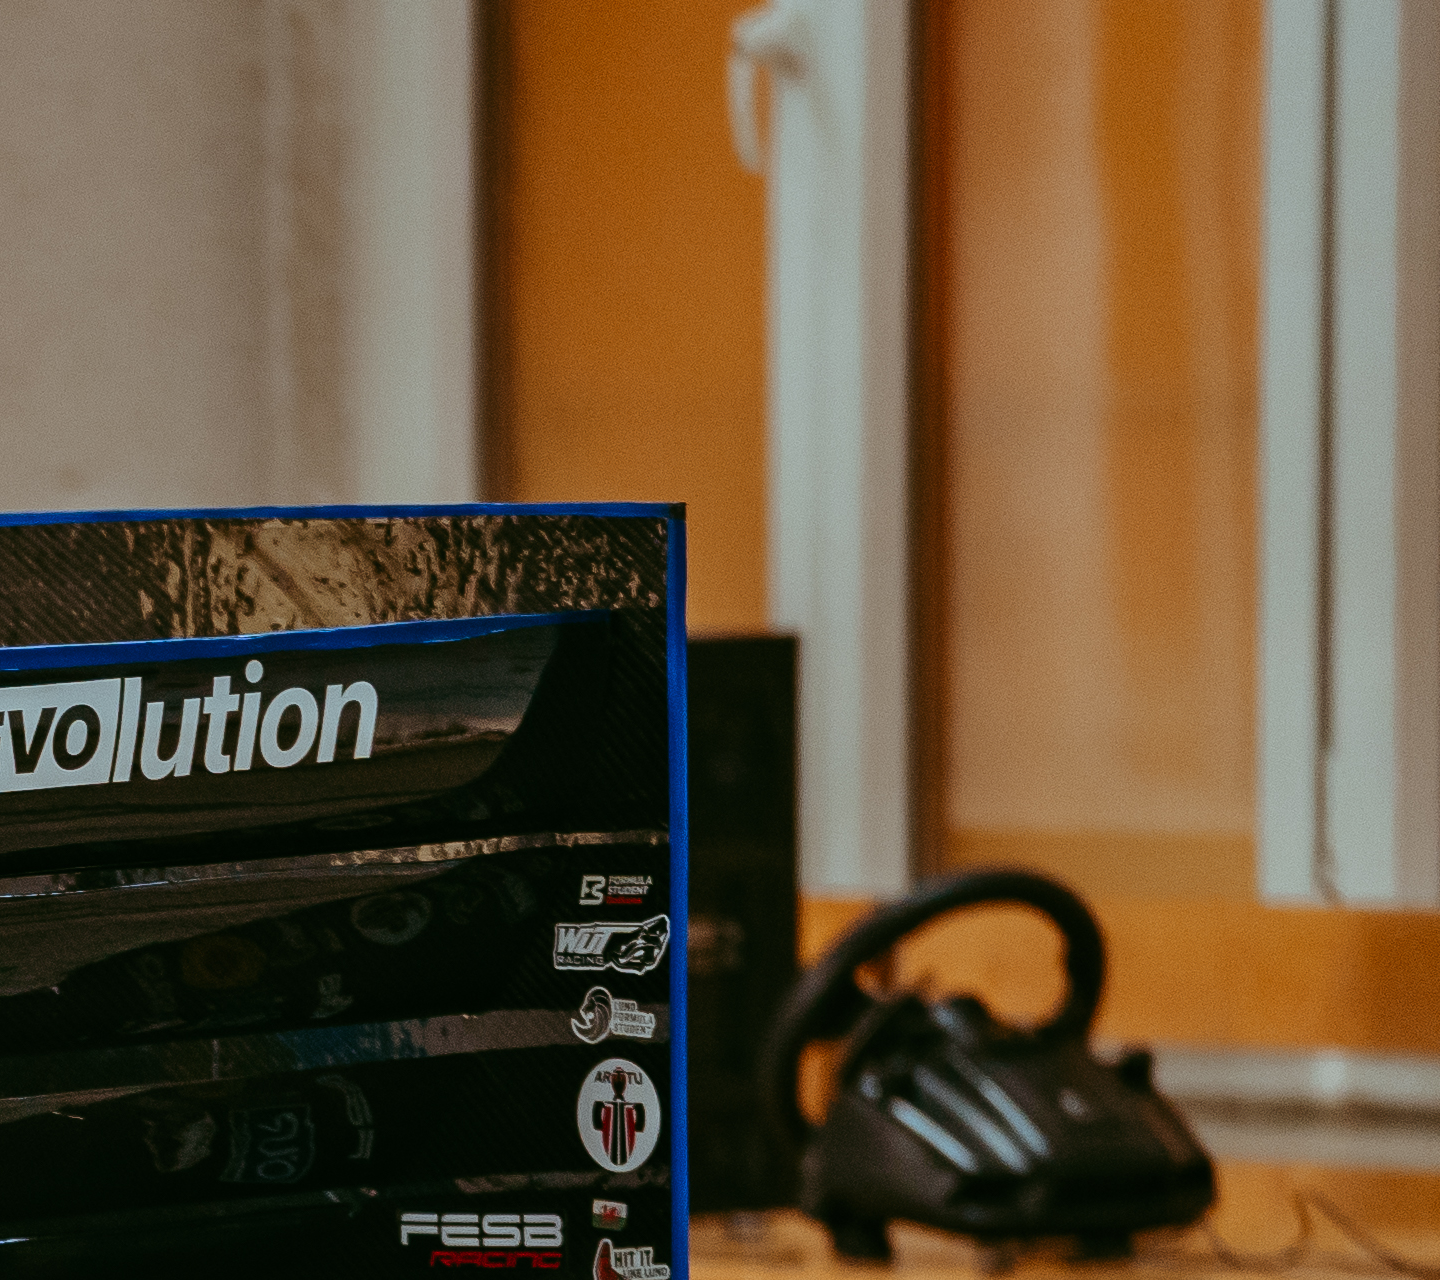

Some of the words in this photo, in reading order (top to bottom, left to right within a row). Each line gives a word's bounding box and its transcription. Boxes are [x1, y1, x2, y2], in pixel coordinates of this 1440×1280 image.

[556, 955, 605, 965] RACING
[400, 1213, 563, 1248] FESB
[430, 1251, 562, 1269] RACING
[613, 1250, 635, 1268] HIT
[639, 1250, 652, 1267] IT
